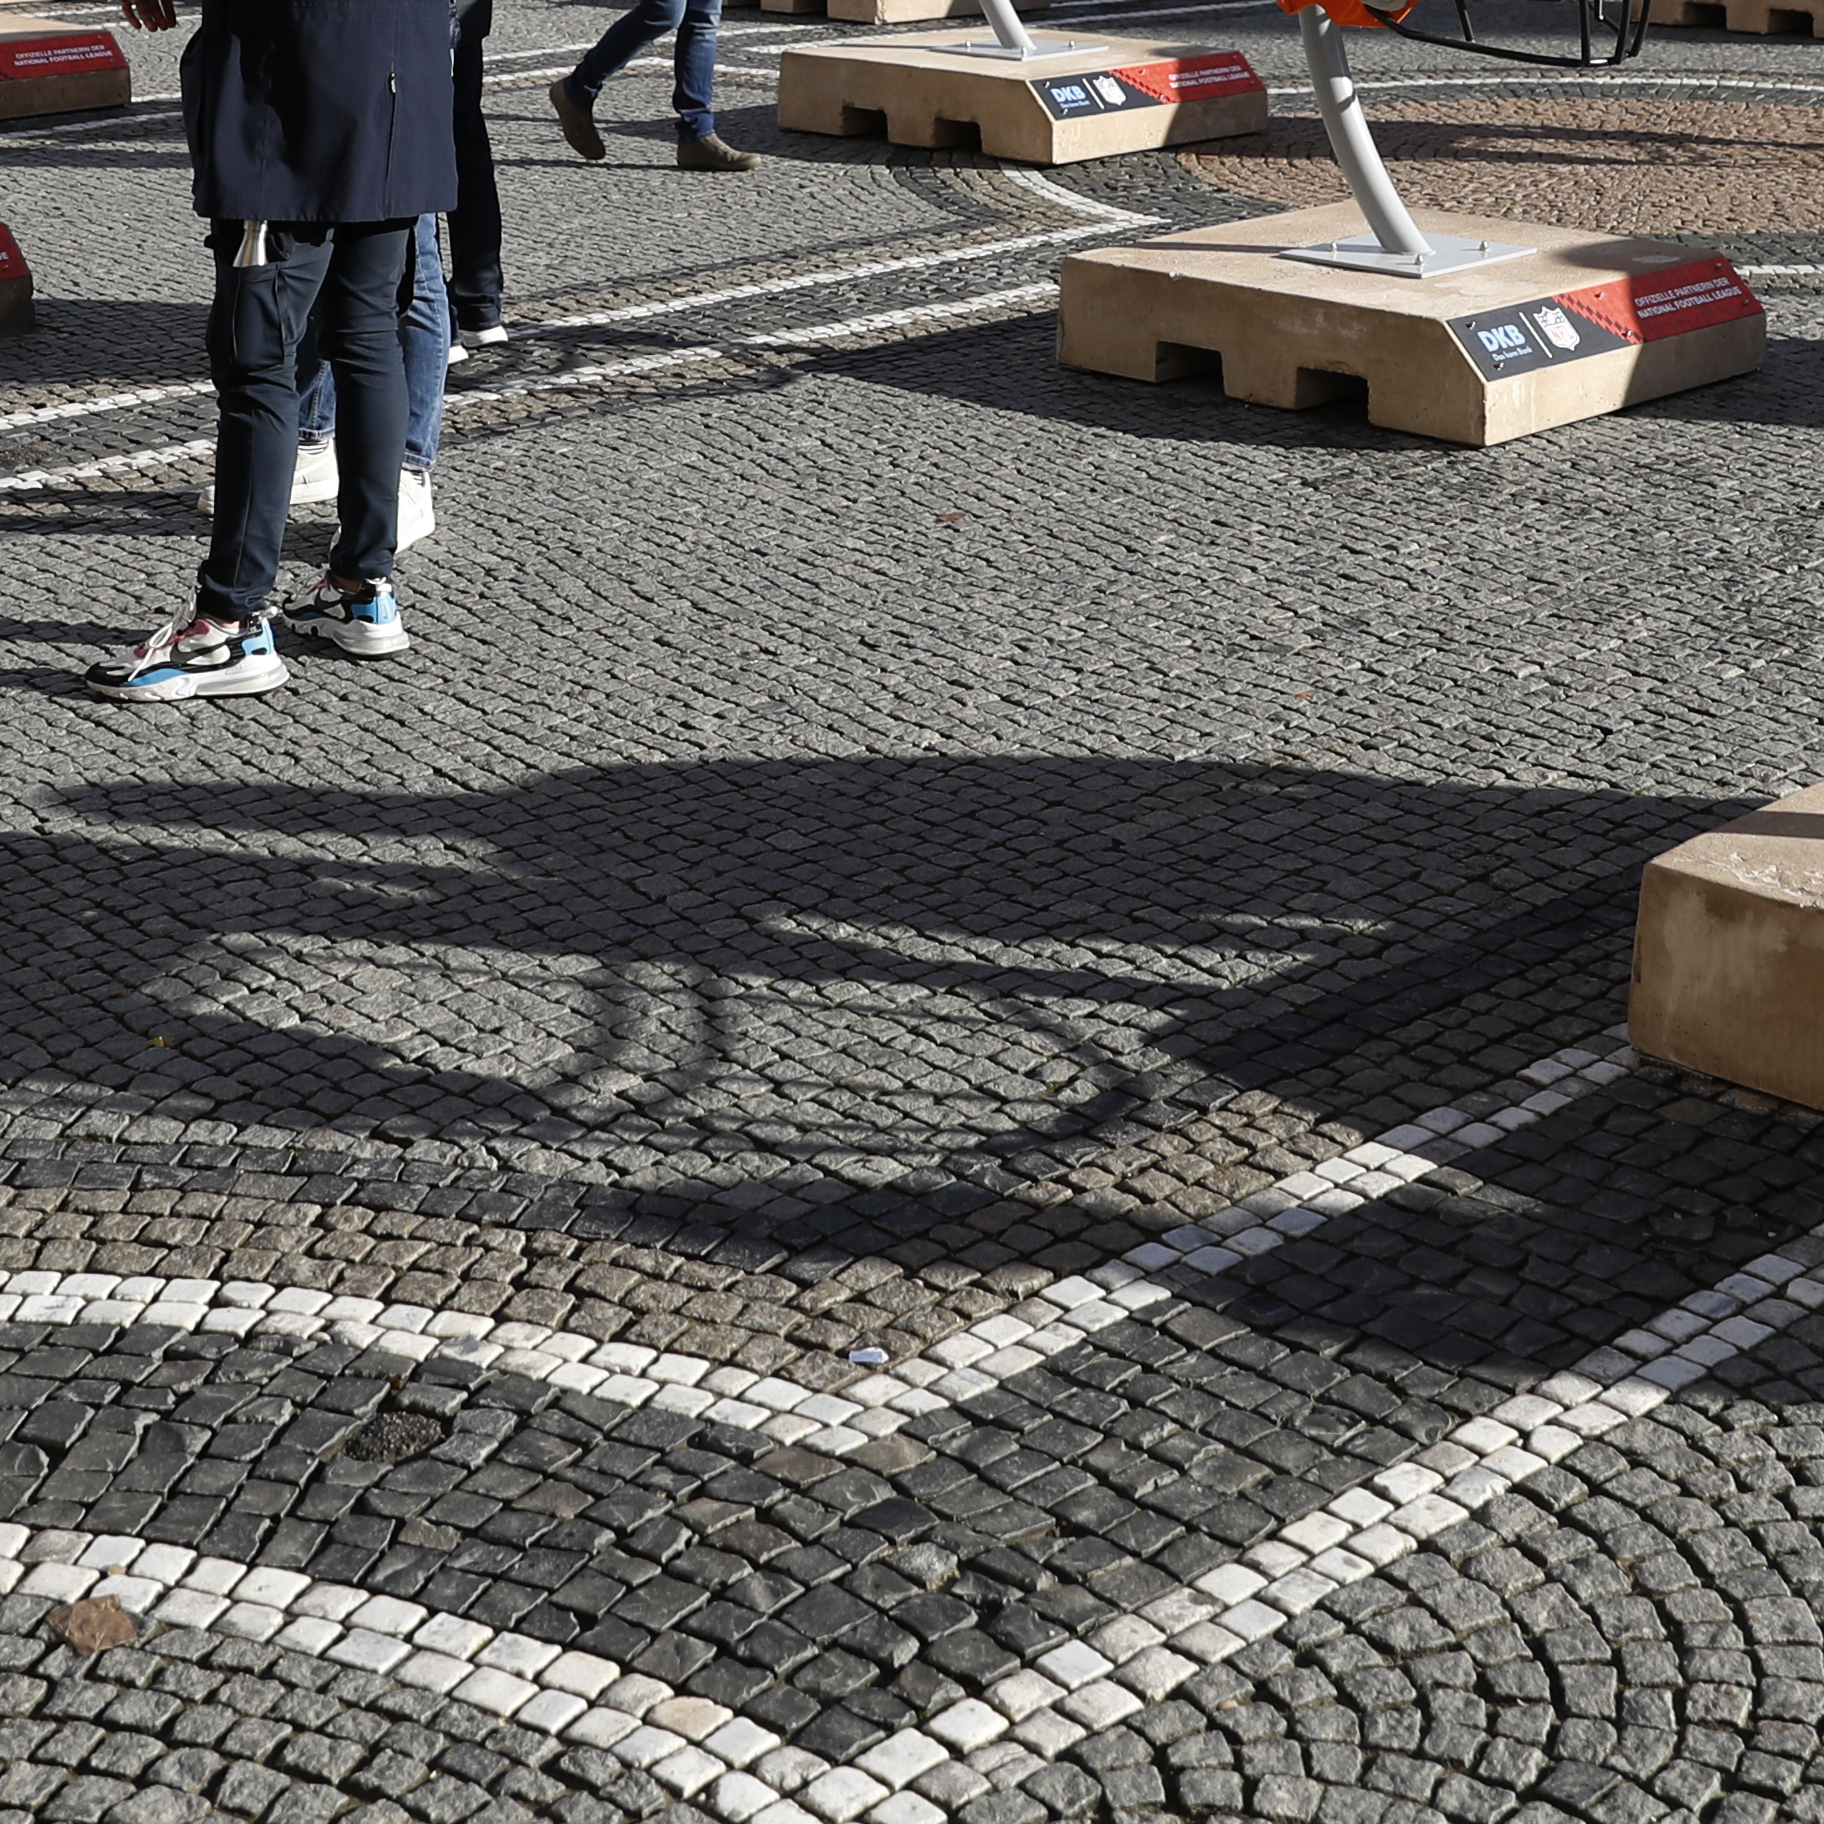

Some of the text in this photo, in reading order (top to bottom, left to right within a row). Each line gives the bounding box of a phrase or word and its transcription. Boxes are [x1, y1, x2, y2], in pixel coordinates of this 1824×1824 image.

[1051, 85, 1086, 102] DKB
[1635, 290, 1674, 307] OFFIZIELLE
[1637, 286, 1743, 318] NATIONAL FOOTBALL LEAGUE
[1477, 324, 1526, 352] DKB
